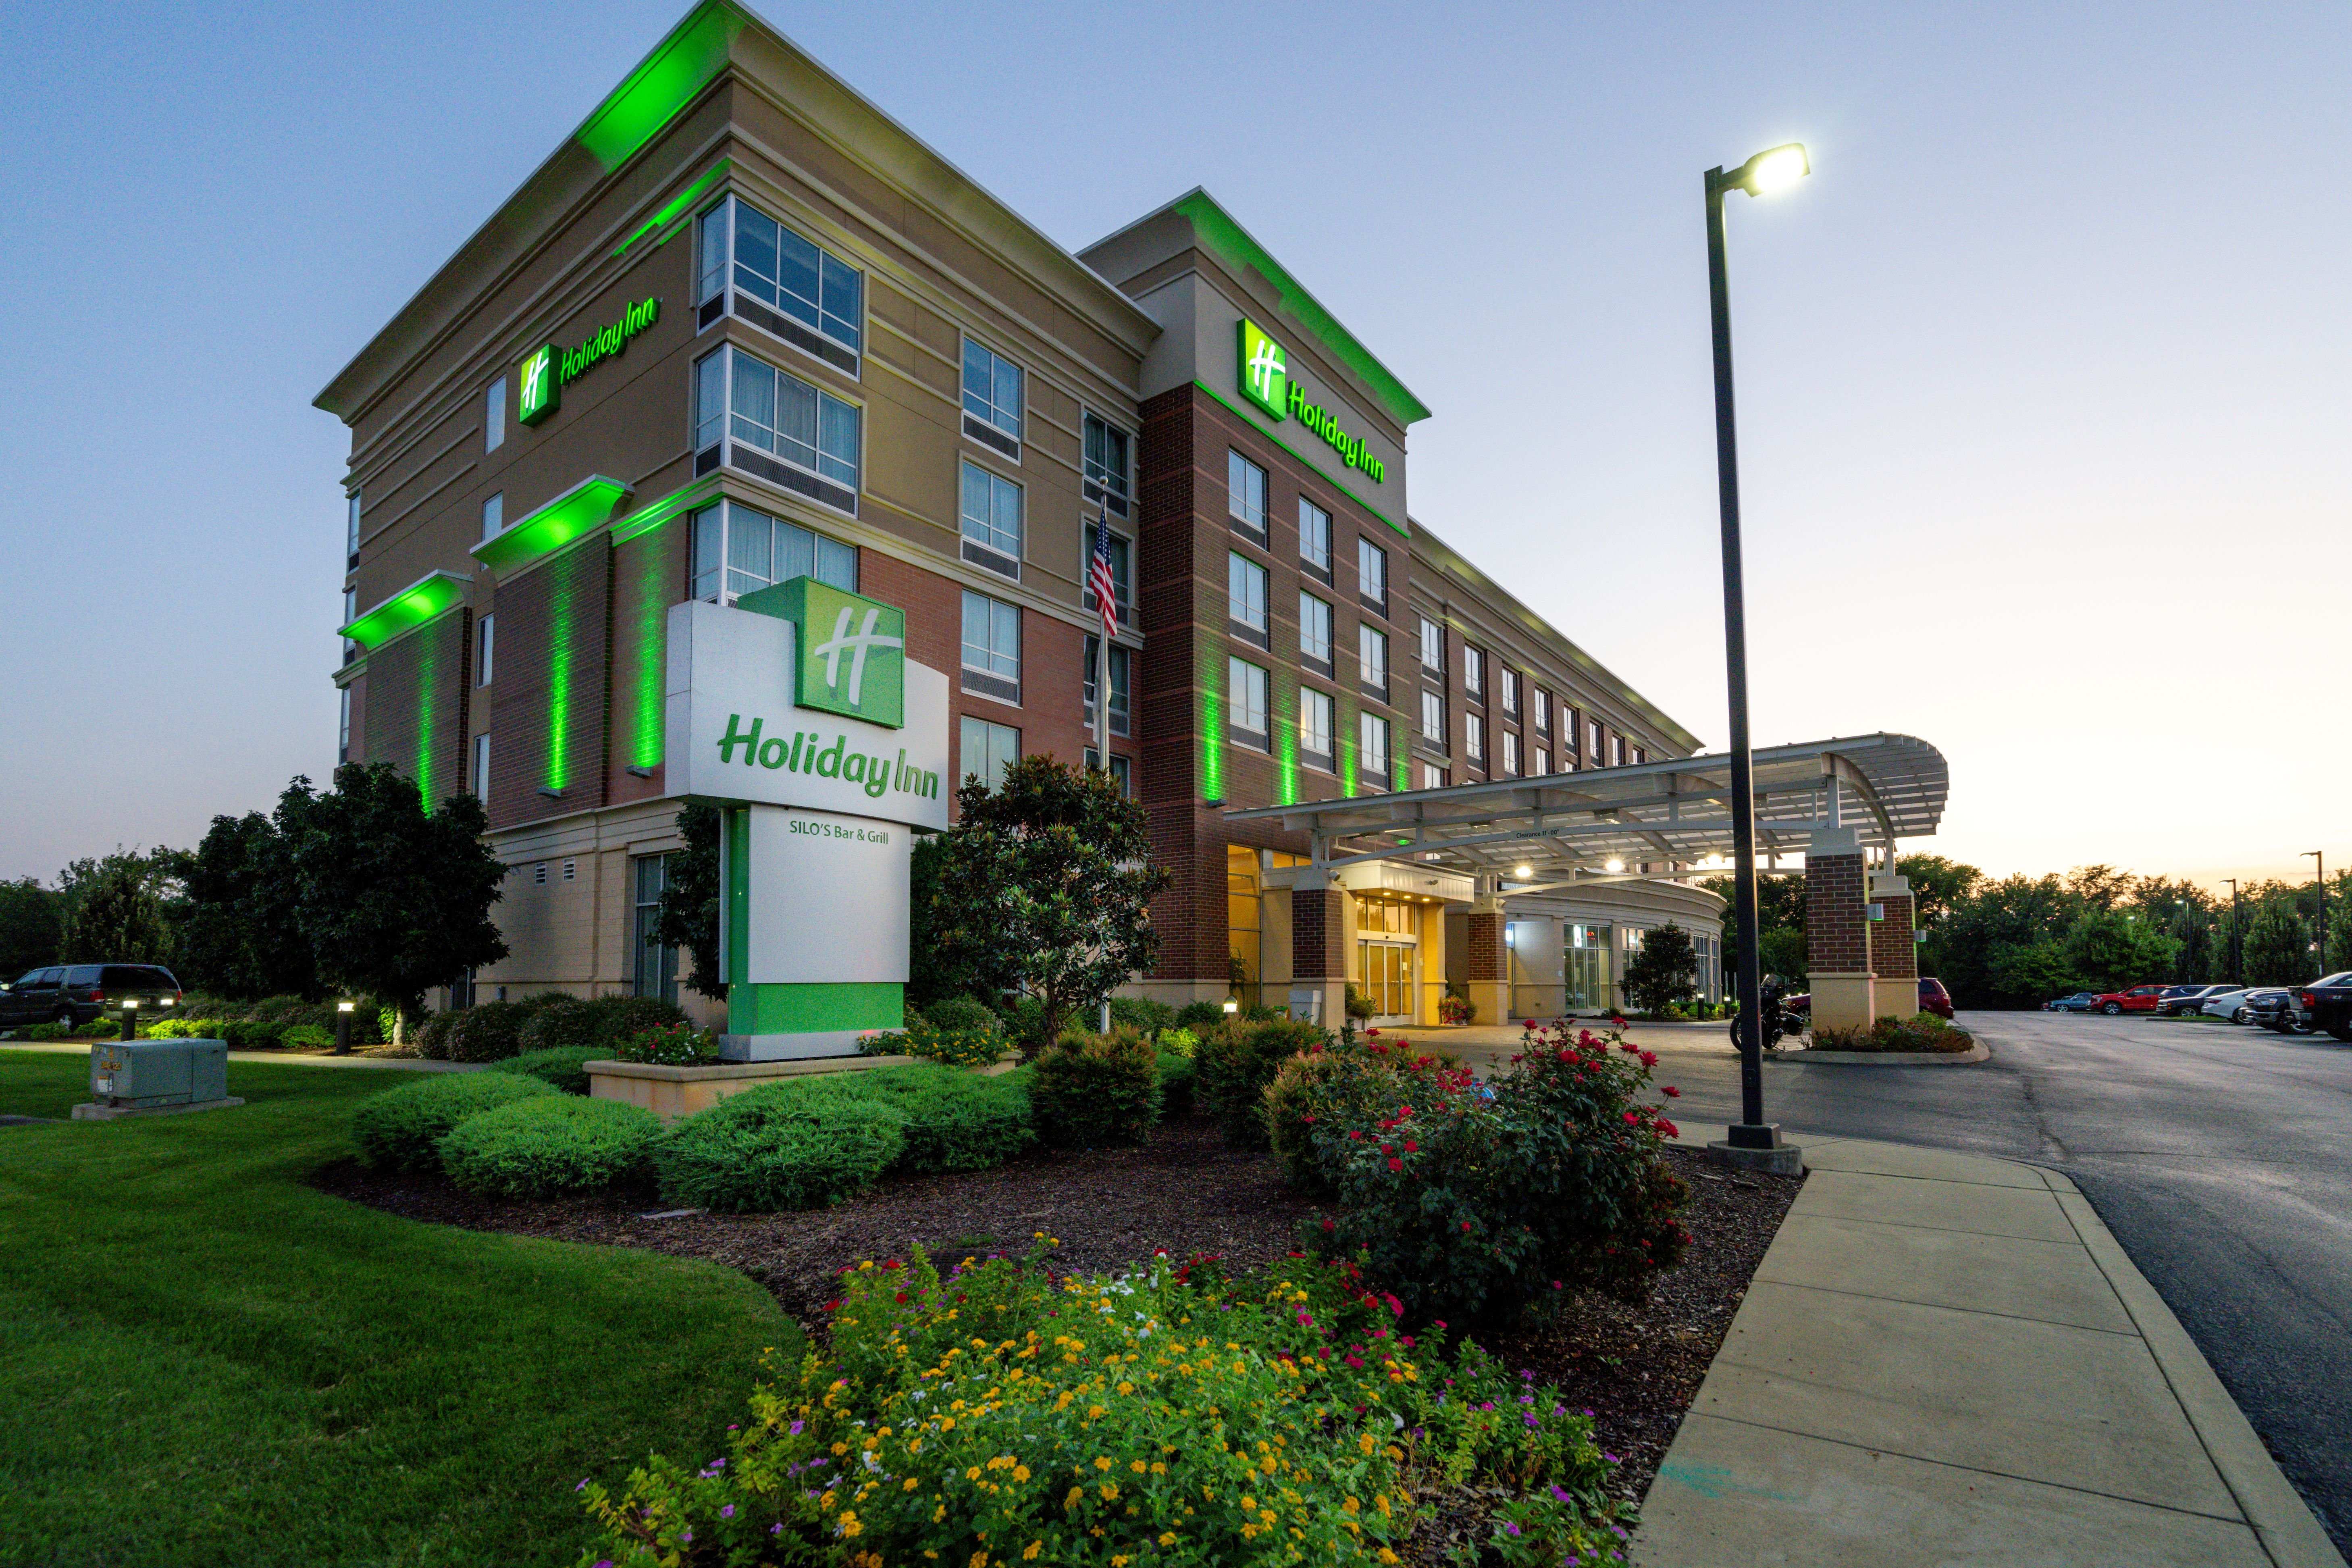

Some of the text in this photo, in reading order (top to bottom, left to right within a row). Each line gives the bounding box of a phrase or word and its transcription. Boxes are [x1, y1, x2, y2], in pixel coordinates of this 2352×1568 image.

[560, 297, 654, 385] Holiday Inn
[1288, 380, 1385, 484] Holiday Inn
[717, 714, 938, 800] Holiday Inn
[790, 820, 888, 844] SILO'S Bar & Grill
